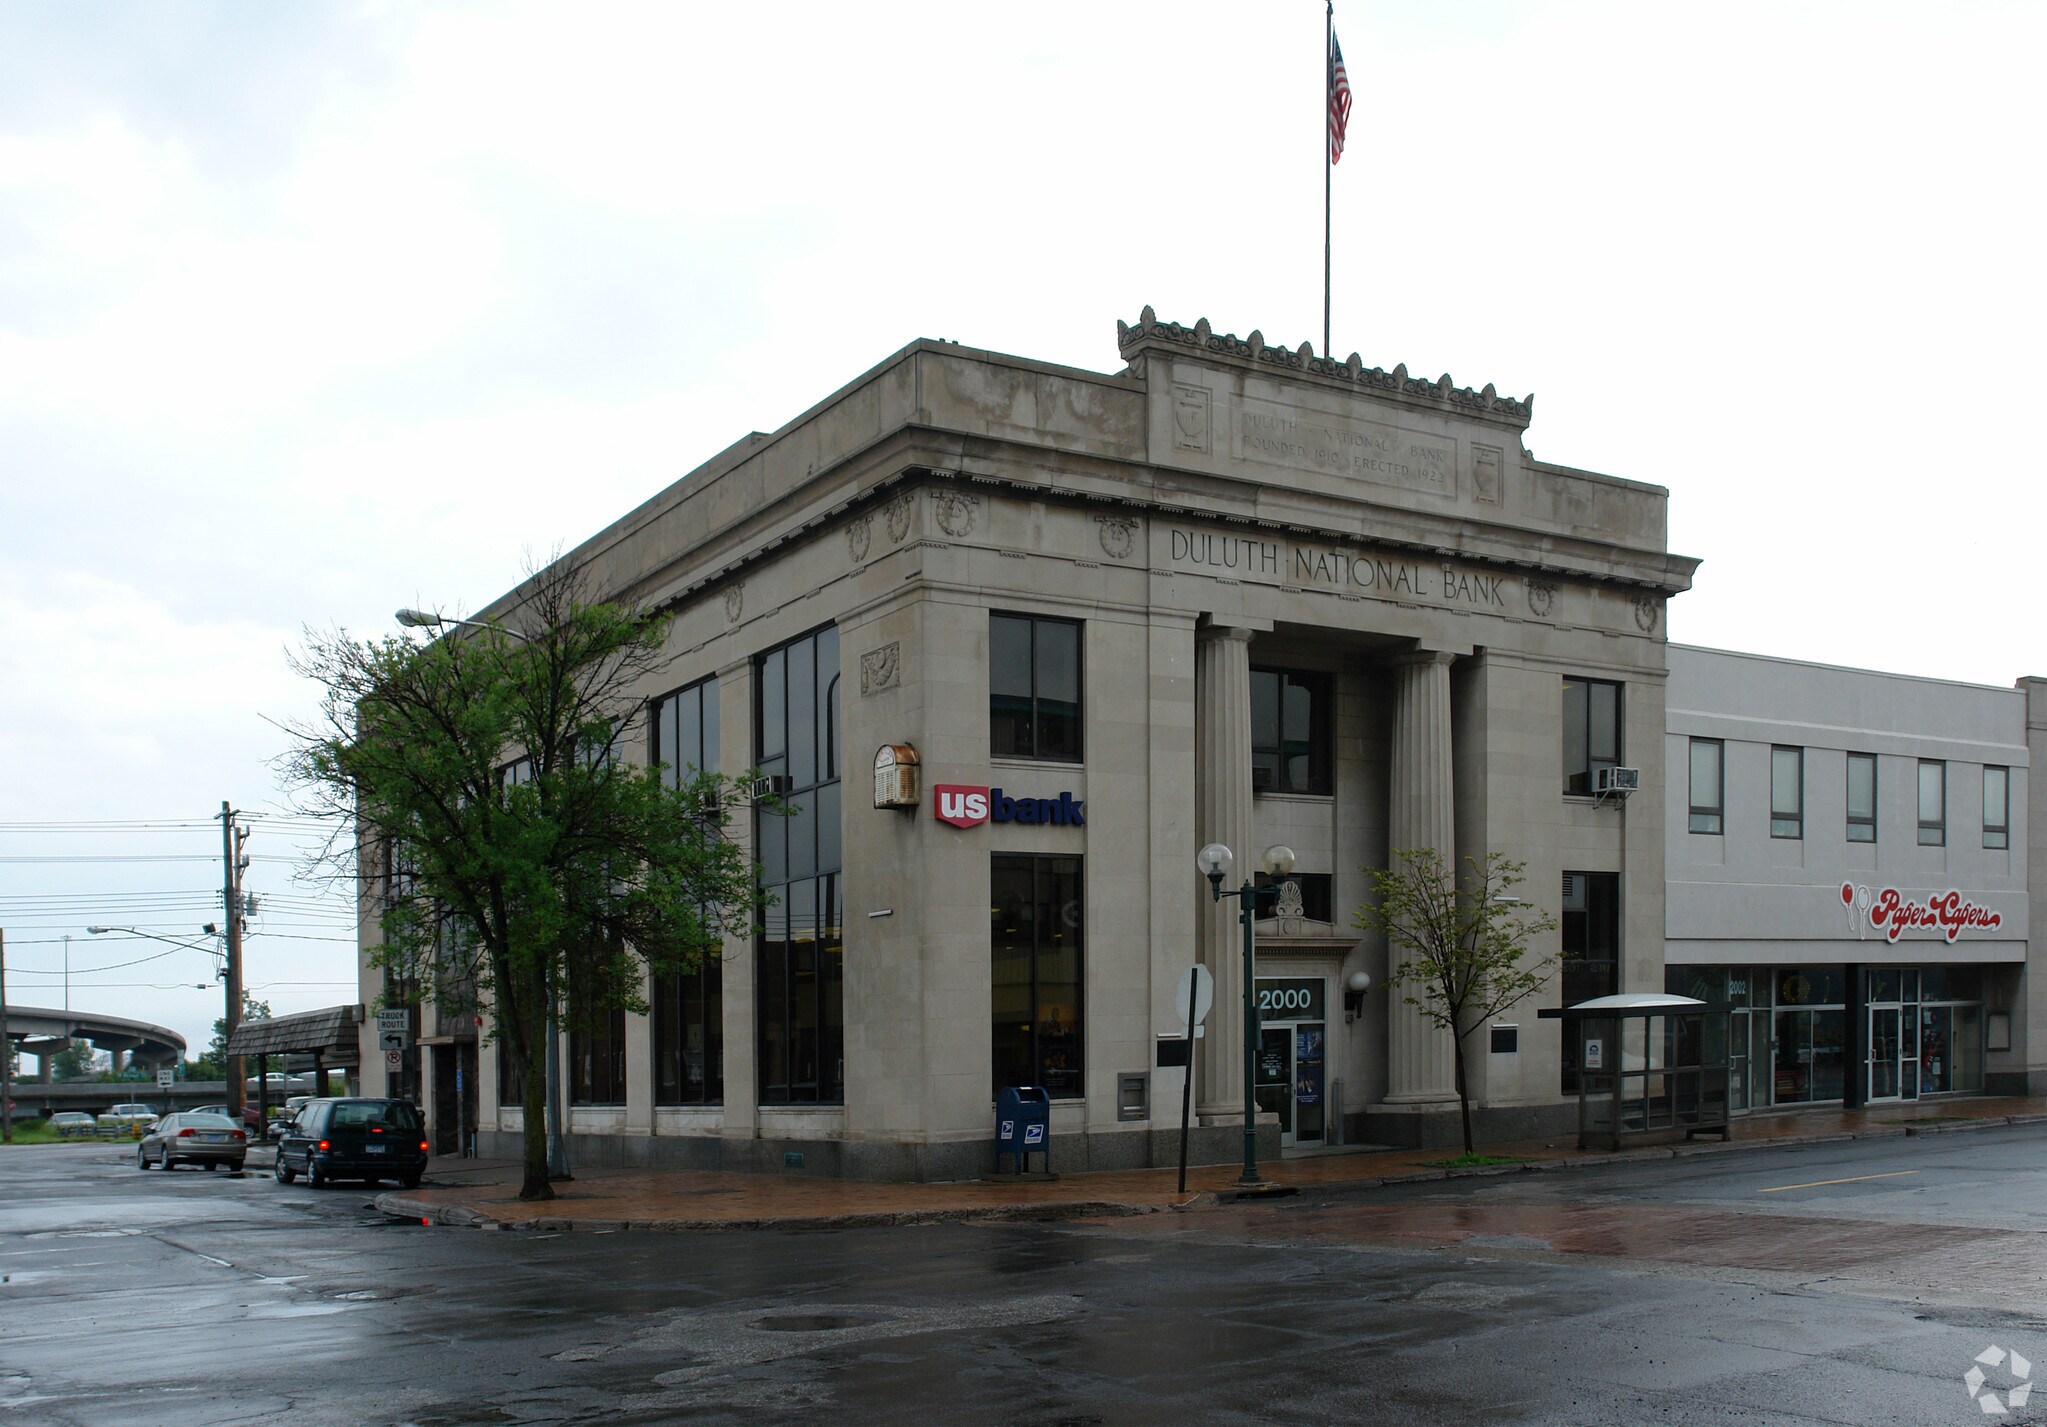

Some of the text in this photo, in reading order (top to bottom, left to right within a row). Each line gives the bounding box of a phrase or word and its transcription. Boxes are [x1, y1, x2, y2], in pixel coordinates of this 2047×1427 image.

[1242, 412, 1443, 463] DULUTH NATIONAL BANK
[1242, 435, 1305, 457] FOUNDED
[1315, 448, 1339, 463] 1910
[1353, 456, 1409, 476] ERECTED
[1172, 529, 1505, 607] DULUTH NATIONAL BANK
[941, 788, 1085, 825] us bank
[1871, 888, 2001, 940] Paper Capers
[1259, 988, 1311, 1010] 2000
[1729, 980, 1746, 995] 2002
[381, 1012, 405, 1020] TRUCK
